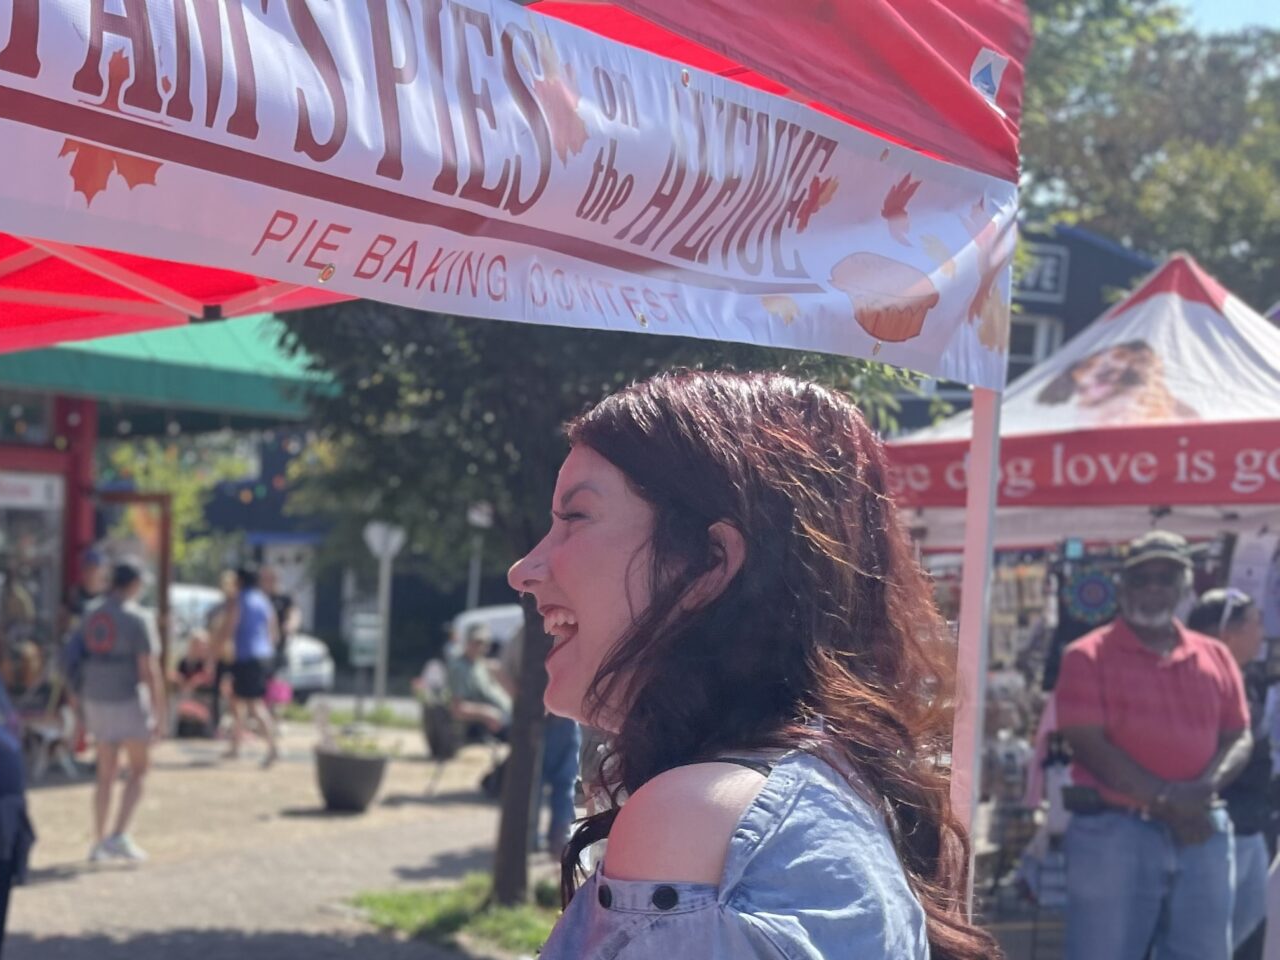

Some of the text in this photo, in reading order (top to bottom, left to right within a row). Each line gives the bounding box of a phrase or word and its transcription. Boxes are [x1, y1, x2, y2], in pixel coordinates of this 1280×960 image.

[593, 66, 639, 129] on
[575, 138, 634, 224] the
[614, 84, 839, 279] AVENUE
[251, 210, 688, 326] PIE BAKING CONTEST
[945, 452, 1036, 498] dg
[1053, 443, 1158, 485] love
[1175, 437, 1216, 484] is
